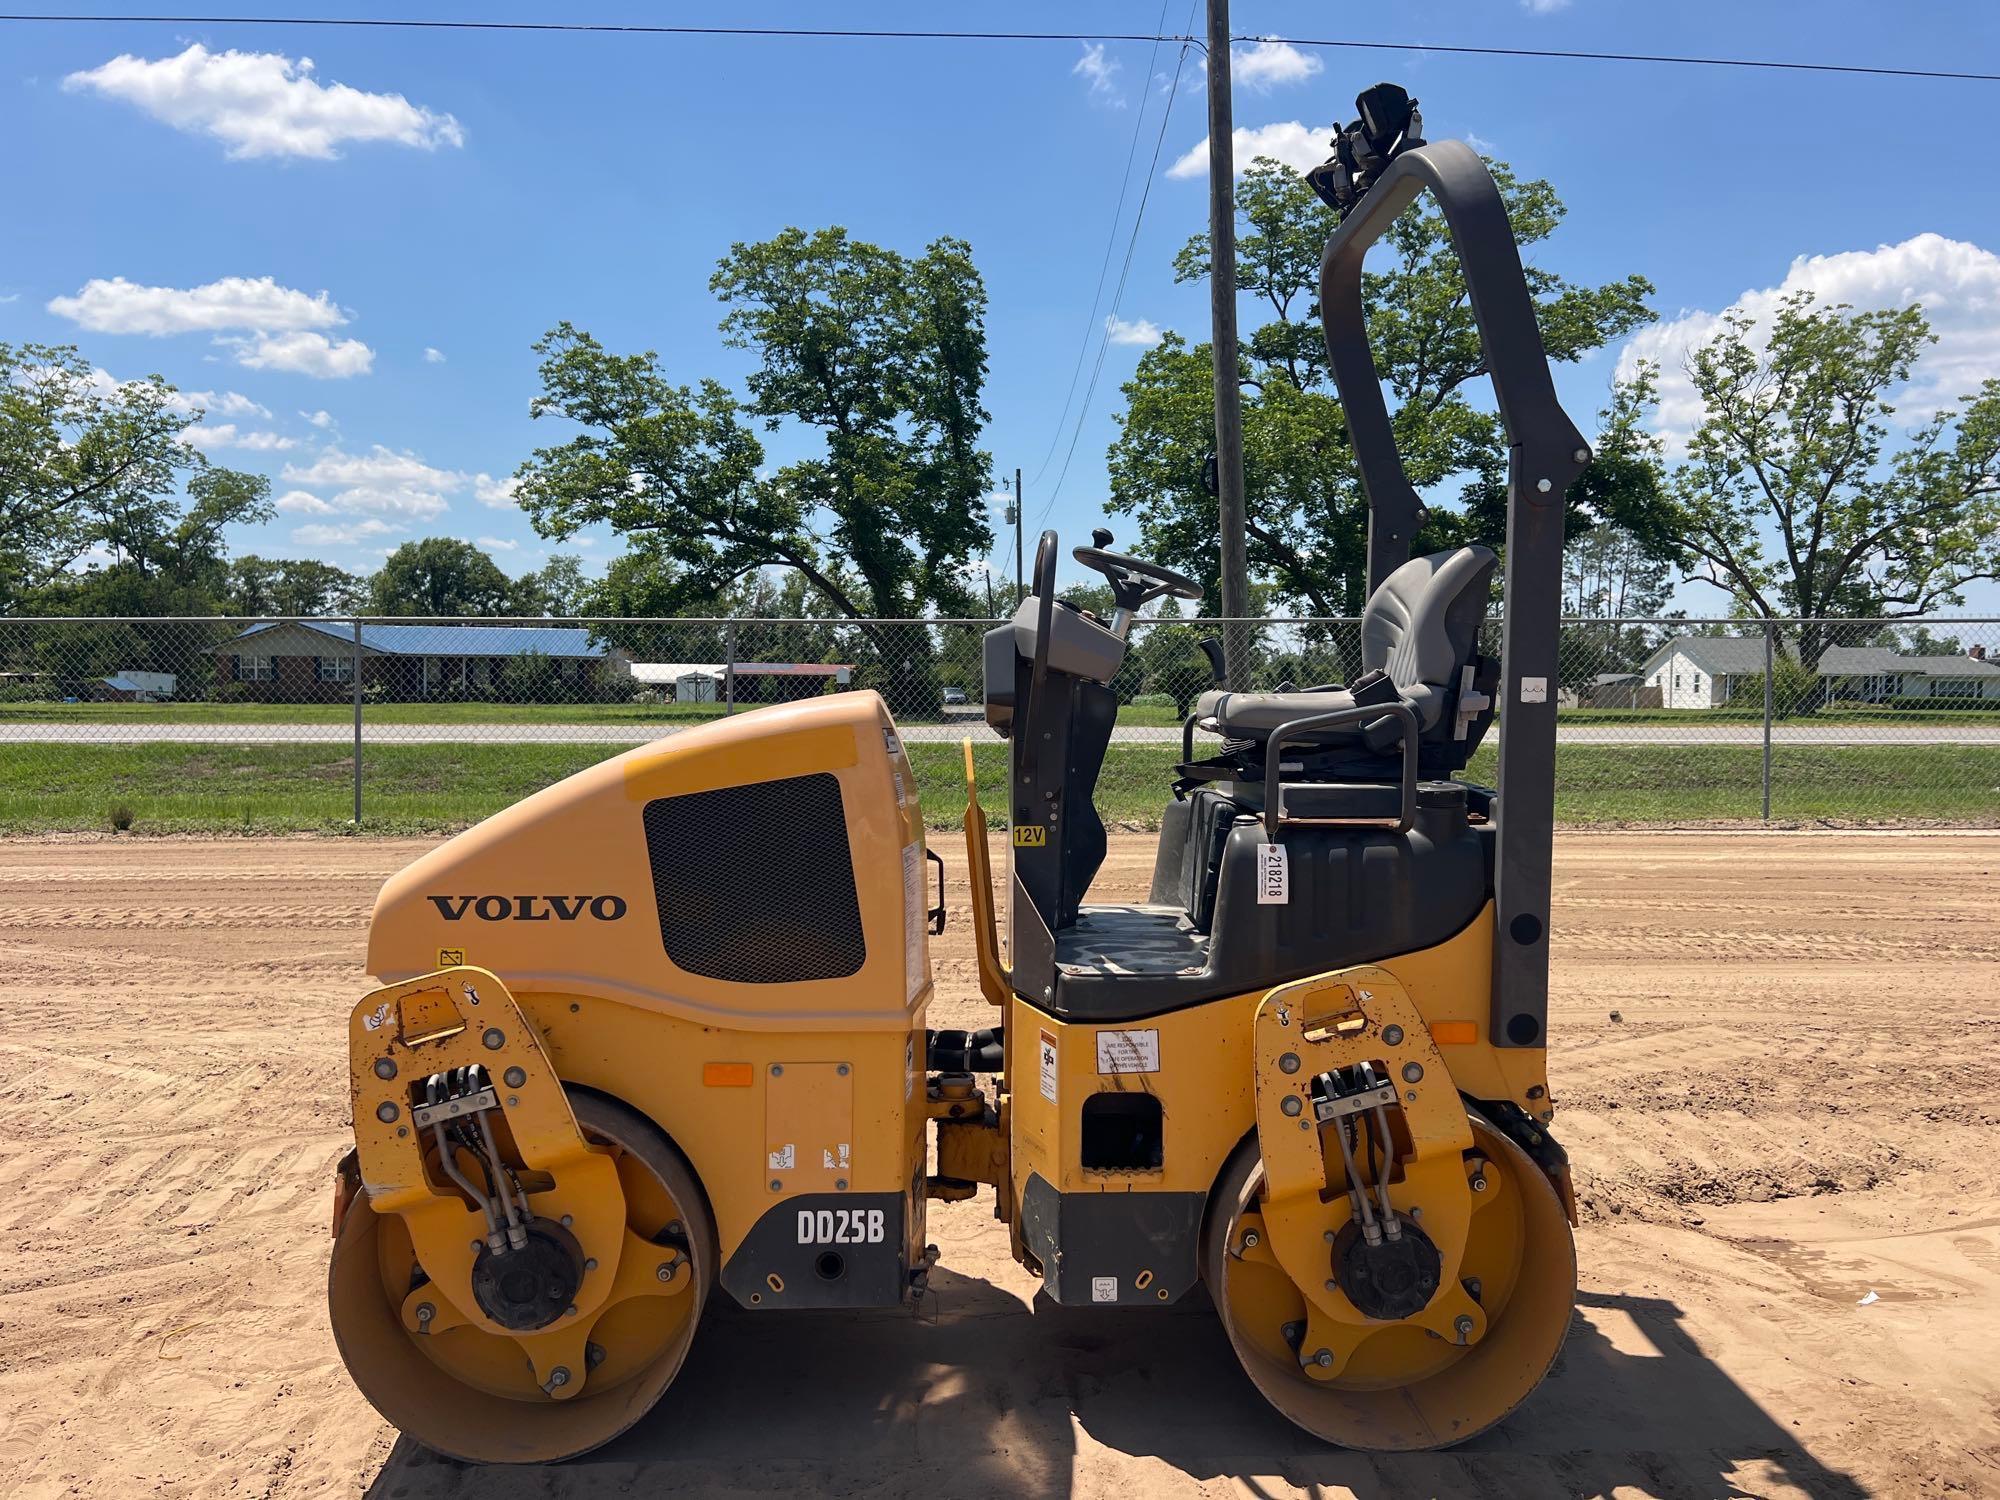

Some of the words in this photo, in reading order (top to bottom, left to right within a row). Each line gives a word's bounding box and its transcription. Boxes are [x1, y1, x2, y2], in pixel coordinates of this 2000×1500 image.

[1015, 827, 1043, 842] 12V
[1268, 856, 1283, 897] 218218
[427, 895, 627, 921] VOLVO
[797, 1209, 885, 1244] DD25B
